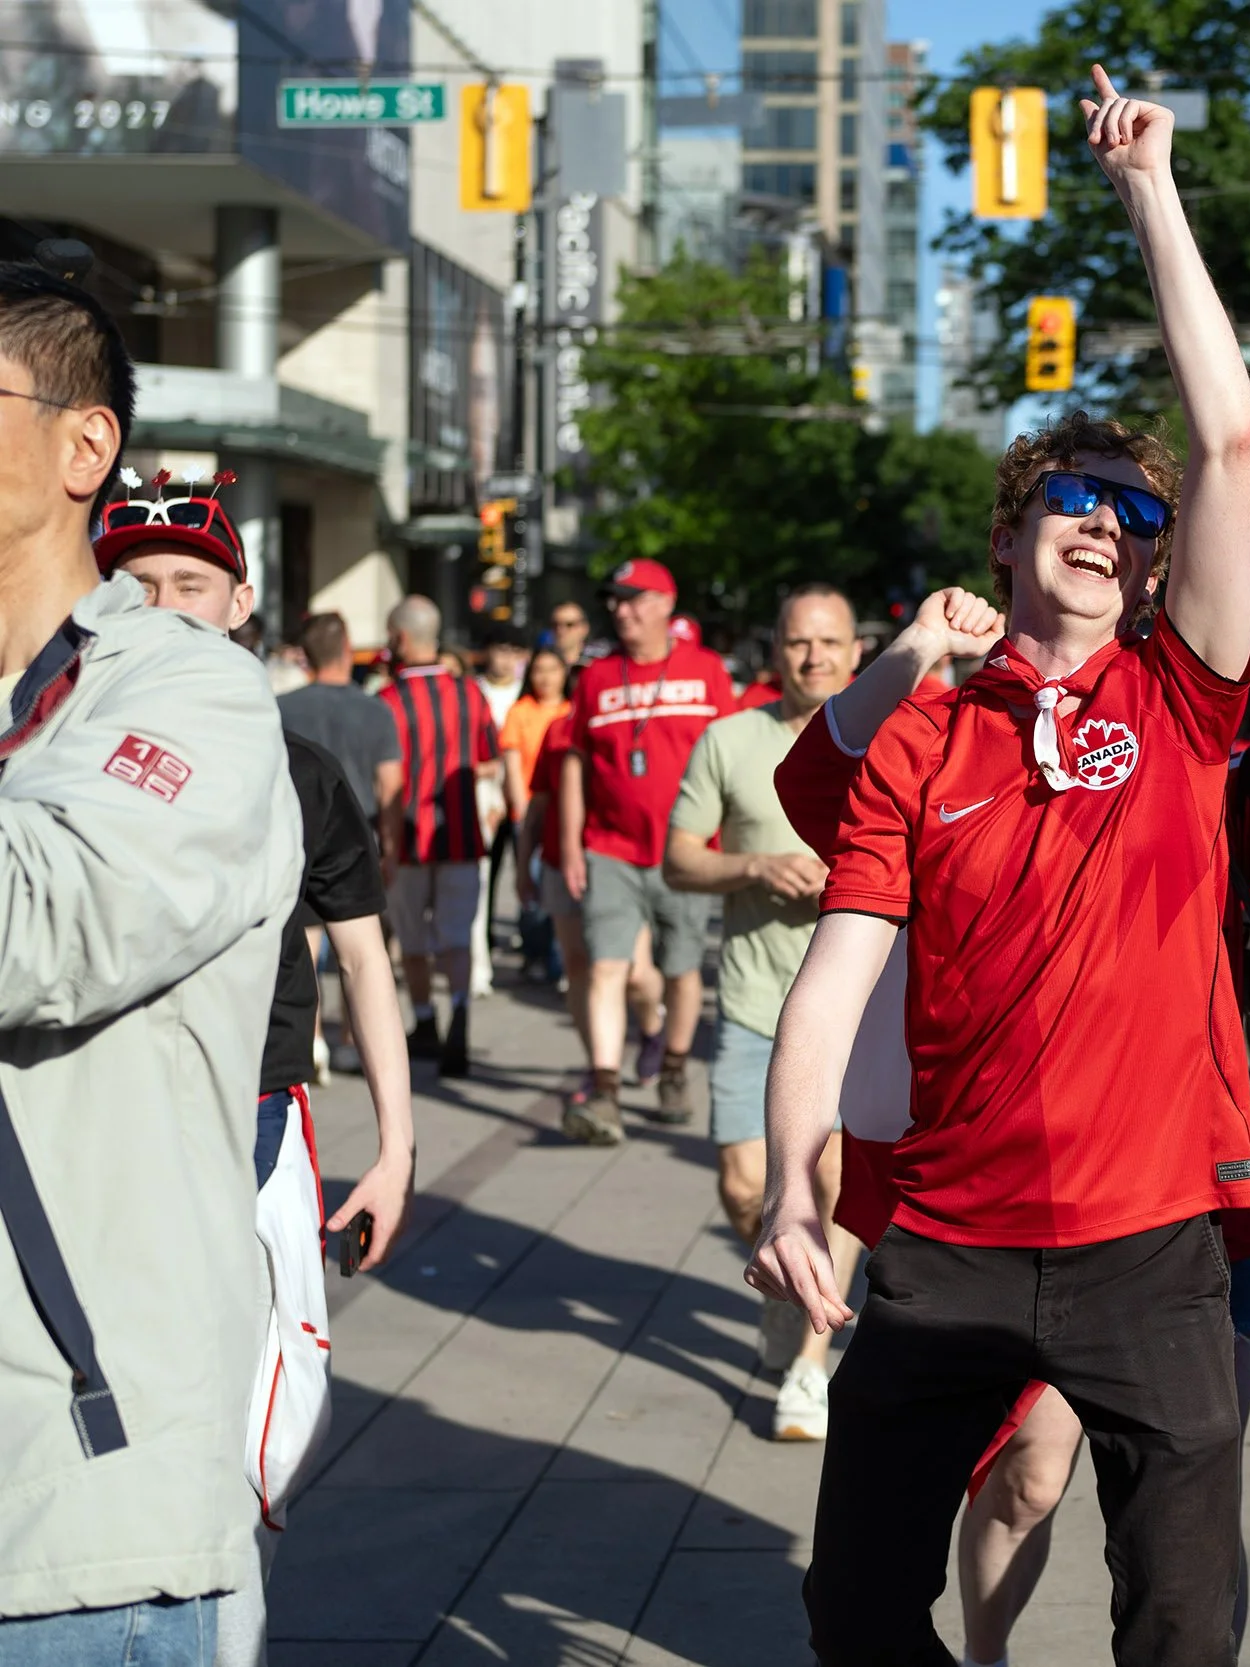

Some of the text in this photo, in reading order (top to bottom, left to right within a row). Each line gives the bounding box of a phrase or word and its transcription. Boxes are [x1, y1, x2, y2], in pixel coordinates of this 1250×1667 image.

[74, 100, 170, 130] 2027
[294, 86, 434, 120] Howe St
[1078, 741, 1134, 769] ANADA
